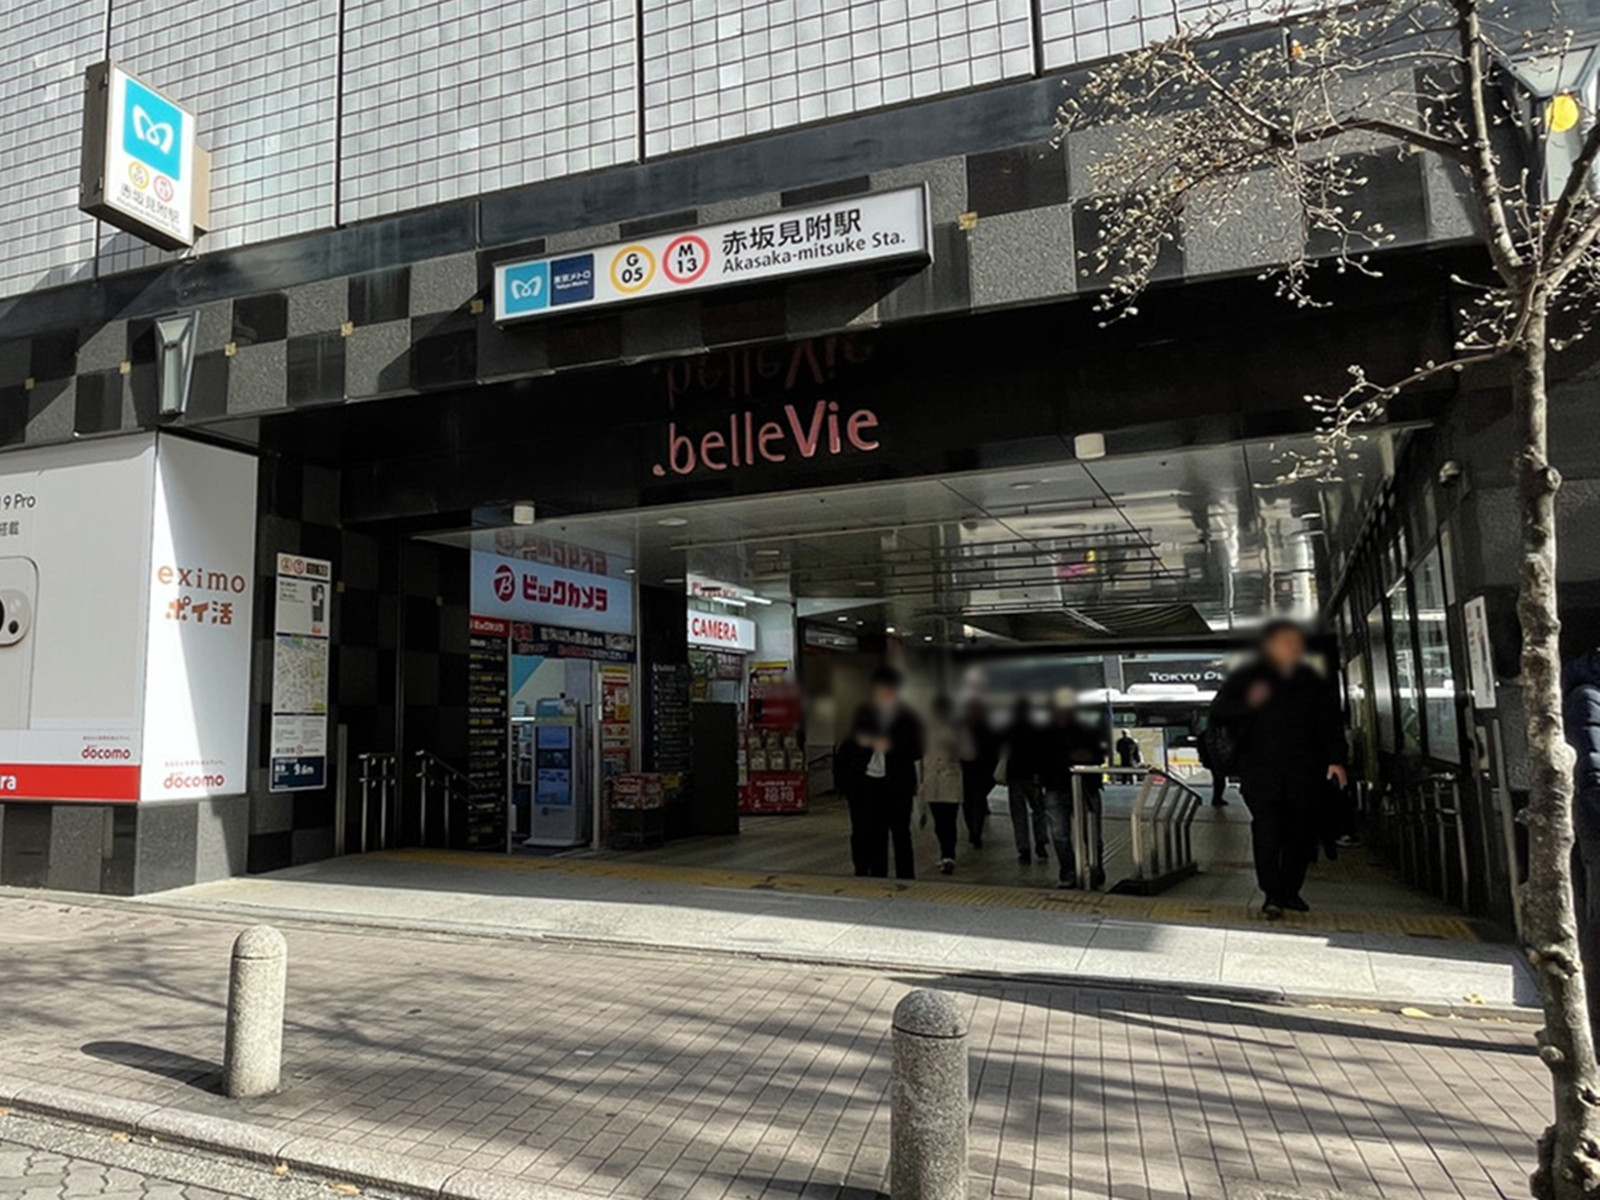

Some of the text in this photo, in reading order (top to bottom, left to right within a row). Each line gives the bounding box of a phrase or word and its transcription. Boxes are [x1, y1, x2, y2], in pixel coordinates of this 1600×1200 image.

[722, 209, 861, 256] 赤坂見附駅
[677, 243, 695, 257] M
[722, 232, 906, 274] Akasaka-mitsuke Sta.
[626, 253, 640, 267] G
[677, 258, 698, 274] 13
[621, 268, 644, 283] 05
[13, 493, 36, 510] Pro
[157, 565, 246, 594] eximo
[522, 573, 608, 612] ビックカメラ
[165, 595, 233, 625] ポイ活
[691, 617, 738, 641] CAMERA
[1149, 671, 1201, 682] TOKYU
[81, 745, 131, 760] docomo
[163, 773, 225, 790] docomo
